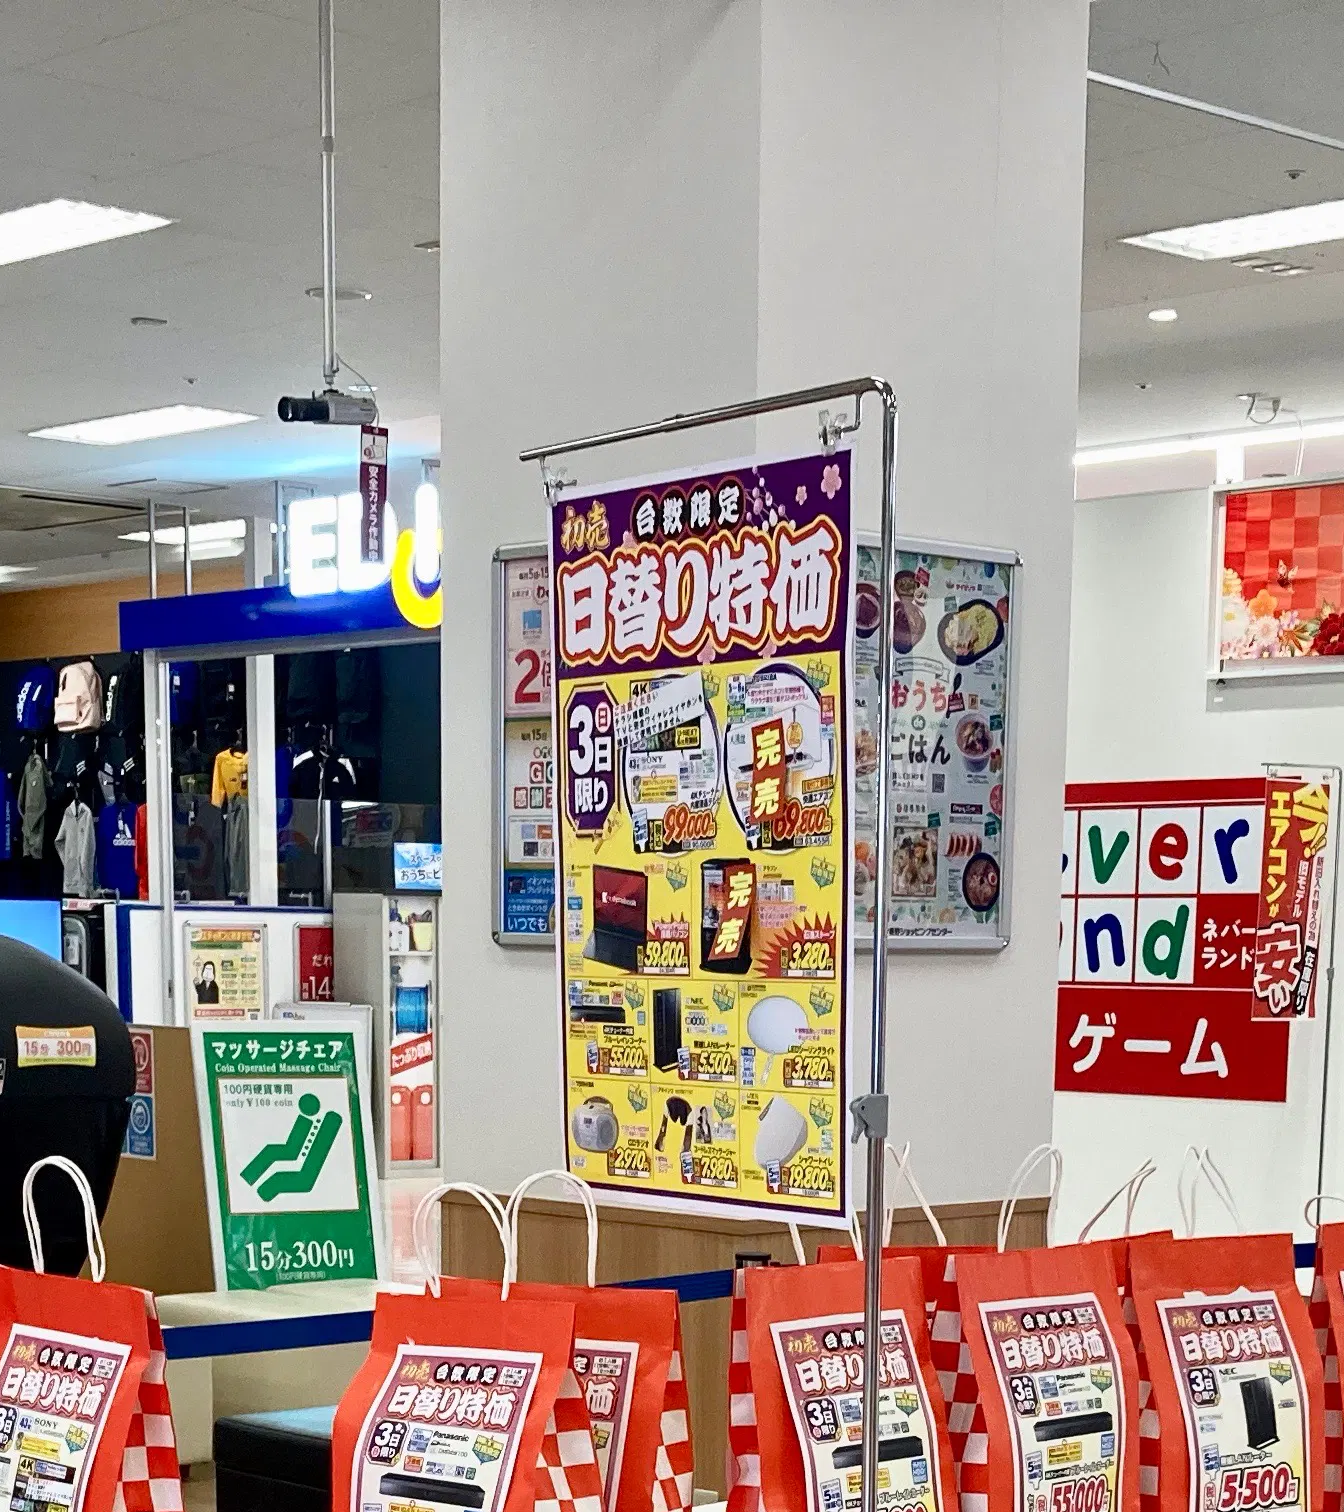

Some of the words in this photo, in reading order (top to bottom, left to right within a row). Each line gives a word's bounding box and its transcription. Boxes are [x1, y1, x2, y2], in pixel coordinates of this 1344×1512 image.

[367, 465, 379, 563] 安全カメラ作動中
[635, 482, 741, 536] 台数限定
[561, 501, 610, 553] 初売
[563, 526, 837, 657] 日替り特価
[632, 682, 648, 697] 4K
[891, 679, 947, 713] おうち
[891, 733, 951, 766] ごはん
[754, 728, 782, 819] 完売
[574, 777, 608, 814] 限り
[663, 803, 717, 845] 99,000円
[1060, 818, 1250, 885] ver
[1266, 790, 1292, 918] エアコンが
[507, 916, 548, 932] いつでも
[715, 871, 753, 955] 完売
[1058, 904, 1190, 981] nd
[1202, 918, 1257, 942] ネバー
[644, 941, 689, 968] 59,800円
[789, 942, 834, 970] 3,280円
[1201, 948, 1256, 971] ランド
[1254, 921, 1302, 1015] 安い
[24, 1041, 50, 1056] 15分
[56, 1041, 91, 1056] 300円
[212, 1039, 344, 1060] マッサージチェア
[609, 1045, 647, 1070] 55,000円
[1068, 1011, 1230, 1079] ゲーム
[215, 1063, 235, 1072] Coin
[238, 1063, 276, 1074] Operated
[280, 1063, 315, 1074] Massage
[318, 1063, 341, 1072] Chair
[697, 1051, 735, 1075] 5,500円
[791, 1056, 833, 1080] 3,780円
[224, 1084, 293, 1095] 100円硬貨専用
[274, 1098, 293, 1107] coin
[614, 1148, 649, 1171] 2,970円
[700, 1156, 735, 1181] 7,980円
[789, 1164, 833, 1192] 19,800円
[1000, 1329, 1106, 1369] 日替り特価
[1179, 1326, 1284, 1362] 日替り特価
[38, 1347, 94, 1375] 台数限定
[435, 1363, 498, 1384] 台数限定
[1218, 1367, 1238, 1376] NEC
[1, 1366, 106, 1418] 日替り特価
[386, 1385, 517, 1428] 日替り特価
[34, 1417, 59, 1428] SONY
[433, 1430, 469, 1442] Panasonic
[20, 1458, 35, 1471] 4K
[1220, 1466, 1297, 1509] 5,500円
